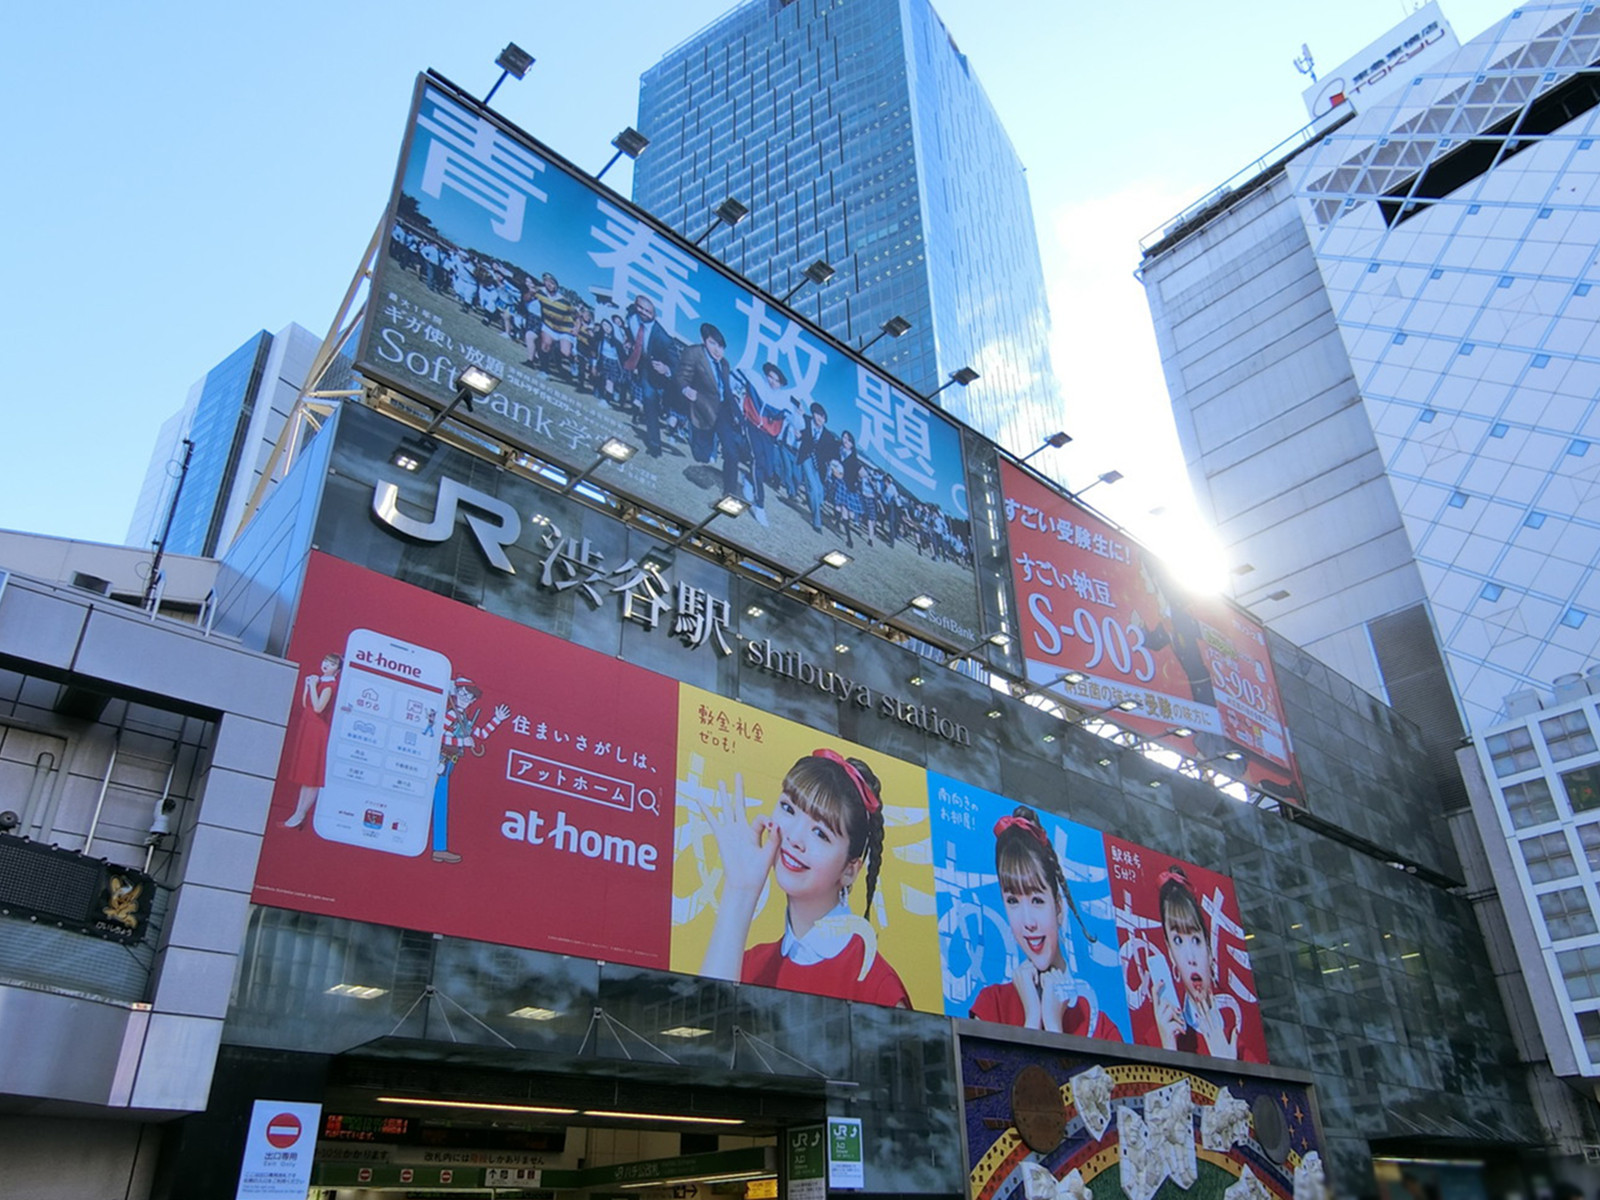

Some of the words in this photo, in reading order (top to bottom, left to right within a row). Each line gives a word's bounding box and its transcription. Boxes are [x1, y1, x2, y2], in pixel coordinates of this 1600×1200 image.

[1348, 28, 1446, 95] TOKYU
[377, 327, 554, 440] Softank
[1015, 551, 1117, 608] すごい納豆
[372, 475, 522, 576] JR
[539, 521, 733, 656] 渋谷駅
[747, 638, 873, 709] shibuya
[881, 694, 972, 747] station
[928, 609, 976, 643] SoftBank
[1027, 592, 1156, 683] S-903
[1211, 659, 1267, 713] S-903
[512, 714, 657, 773] 住まいさがしは、
[516, 759, 626, 802] アットホーム
[792, 1132, 808, 1147] JR
[833, 1124, 848, 1137] JR
